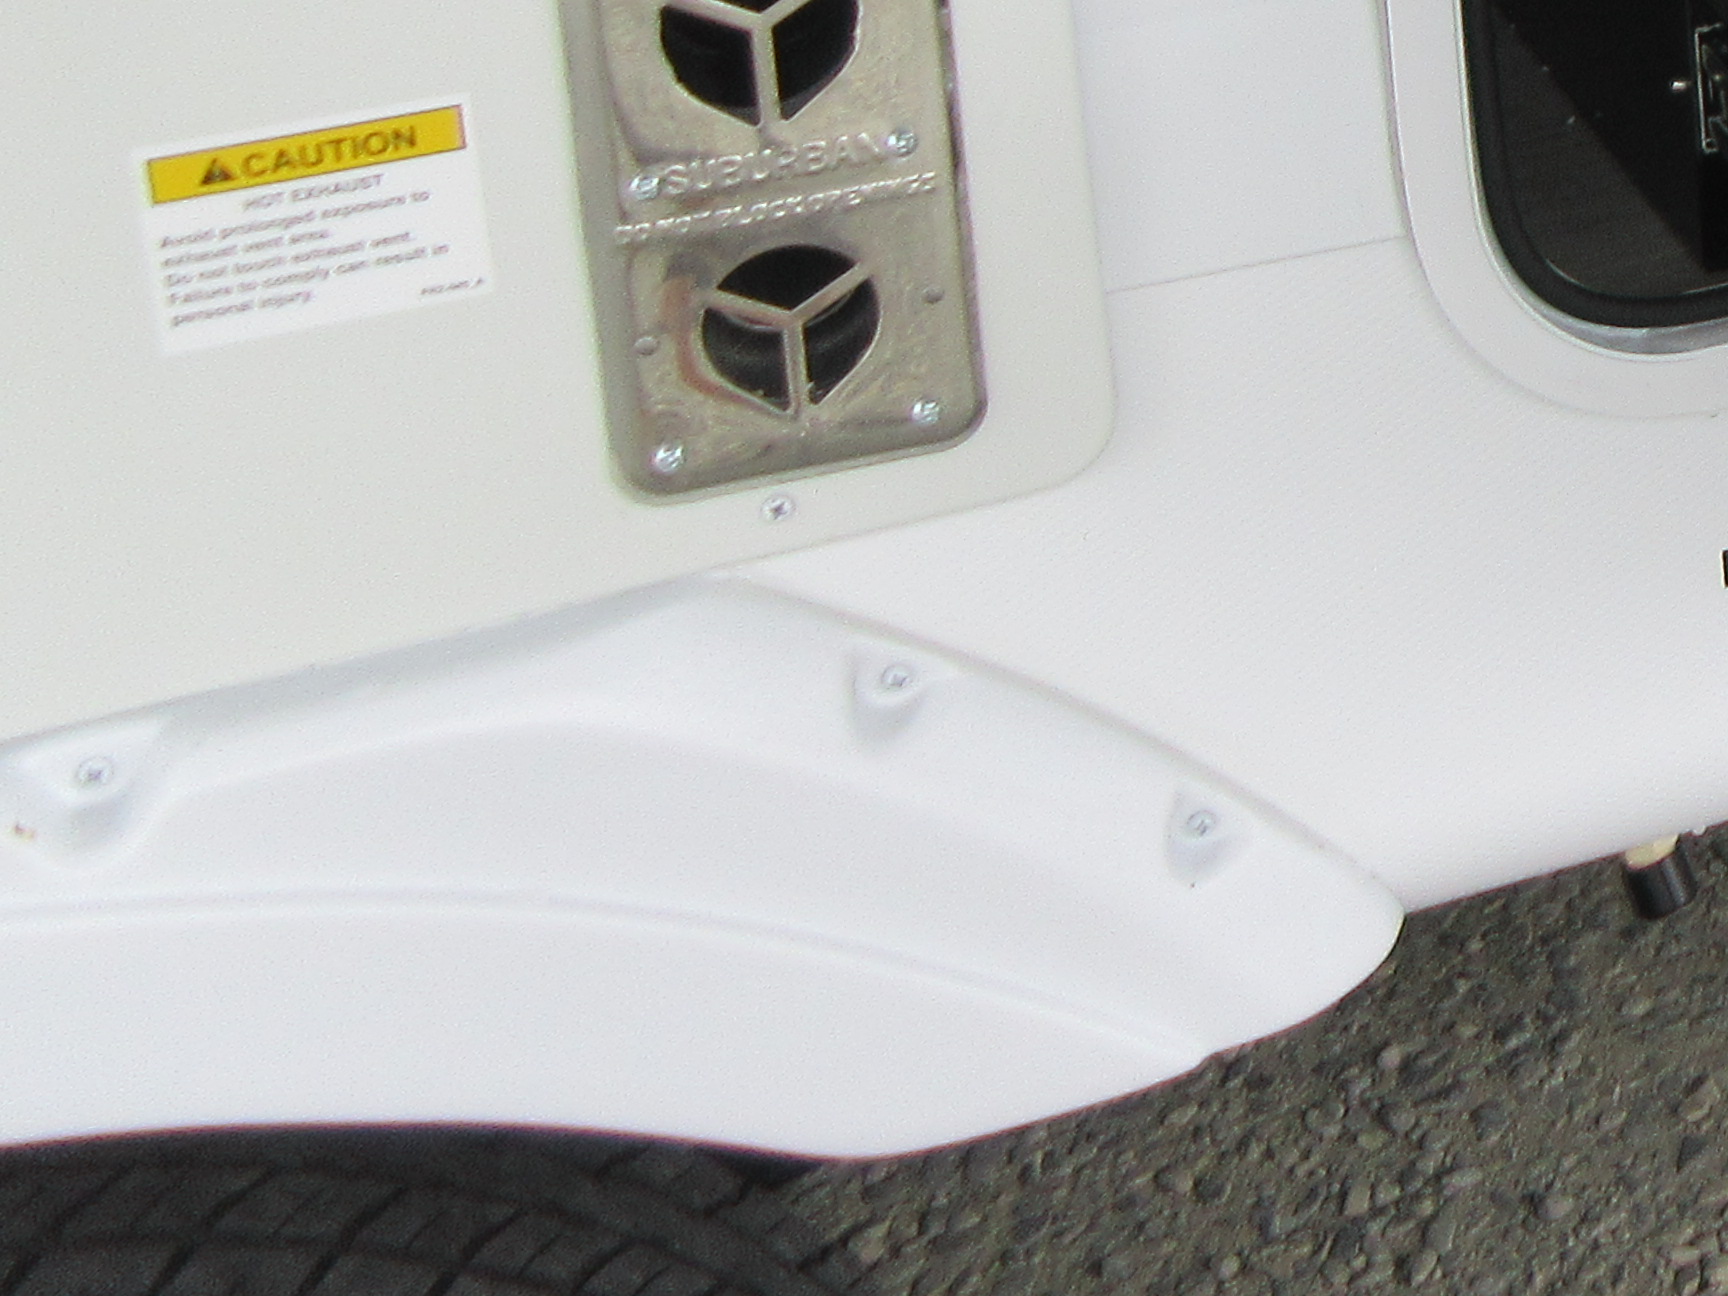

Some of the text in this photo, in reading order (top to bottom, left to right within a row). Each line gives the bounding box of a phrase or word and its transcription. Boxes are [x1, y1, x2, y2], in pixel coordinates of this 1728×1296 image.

[242, 126, 416, 178] CAUTION
[664, 131, 881, 195] SUBURBAN
[291, 174, 384, 202] EXHAUST
